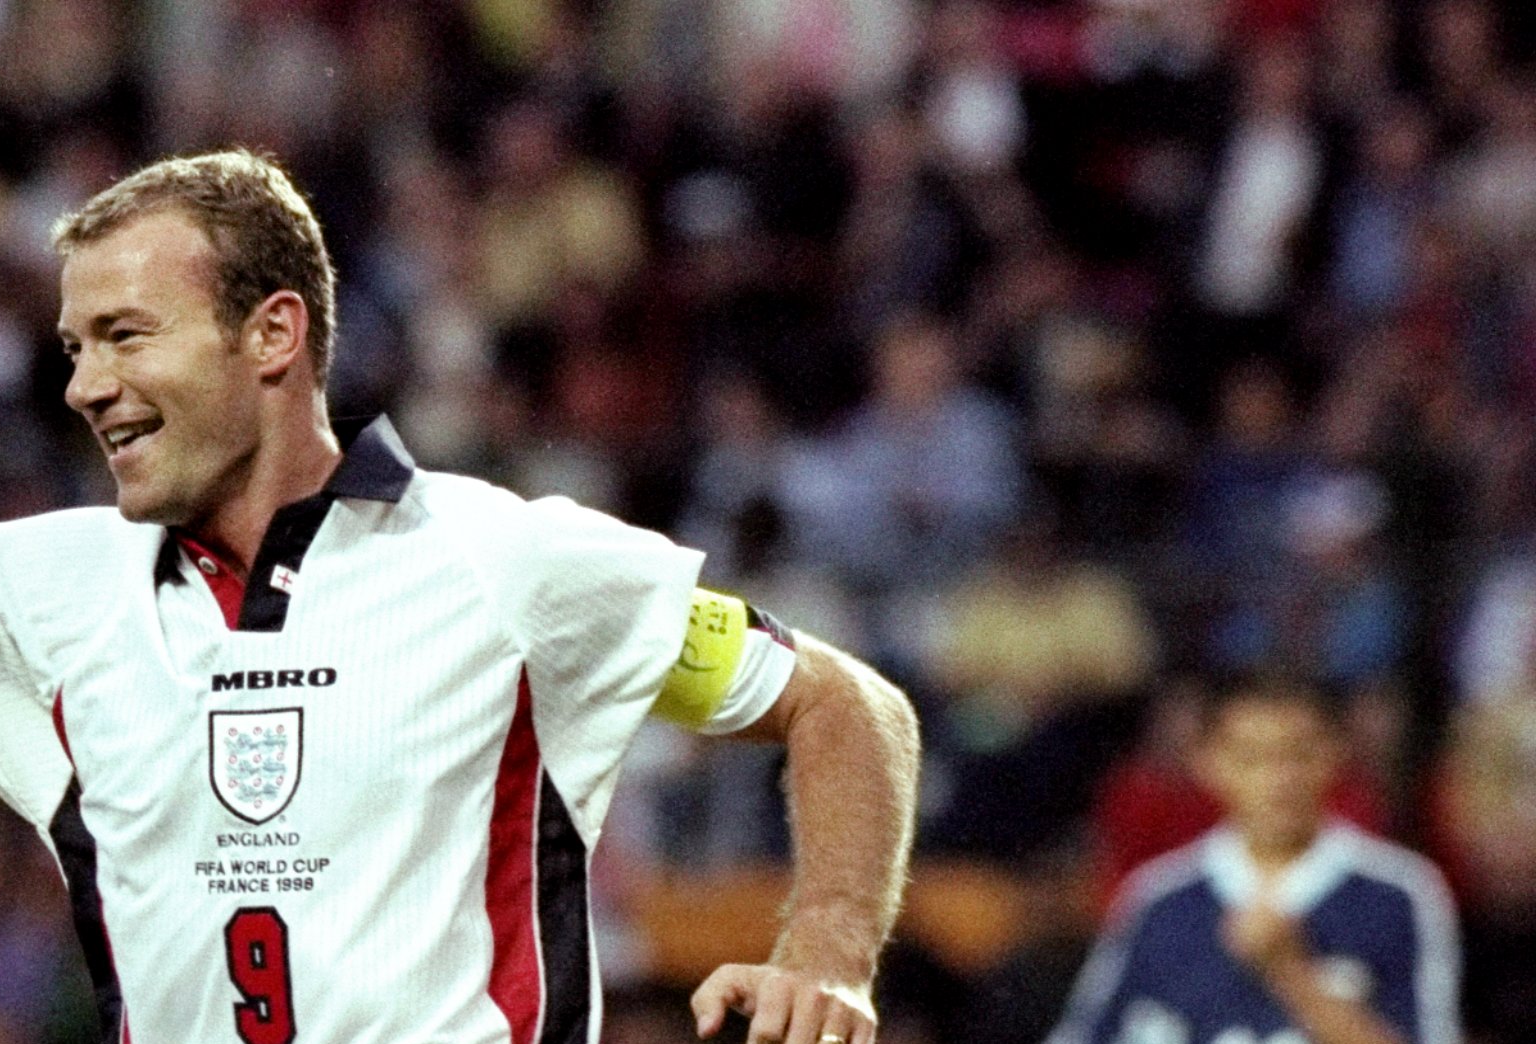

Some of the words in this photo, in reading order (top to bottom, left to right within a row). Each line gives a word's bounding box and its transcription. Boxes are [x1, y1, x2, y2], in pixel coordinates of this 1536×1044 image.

[211, 667, 337, 692] MBRO
[217, 832, 300, 848] ENGLAND
[195, 860, 226, 876] FIFA
[230, 860, 288, 875] WORLD
[293, 858, 330, 873] CUP
[208, 879, 270, 894] FRANCE
[276, 877, 314, 892] 1998
